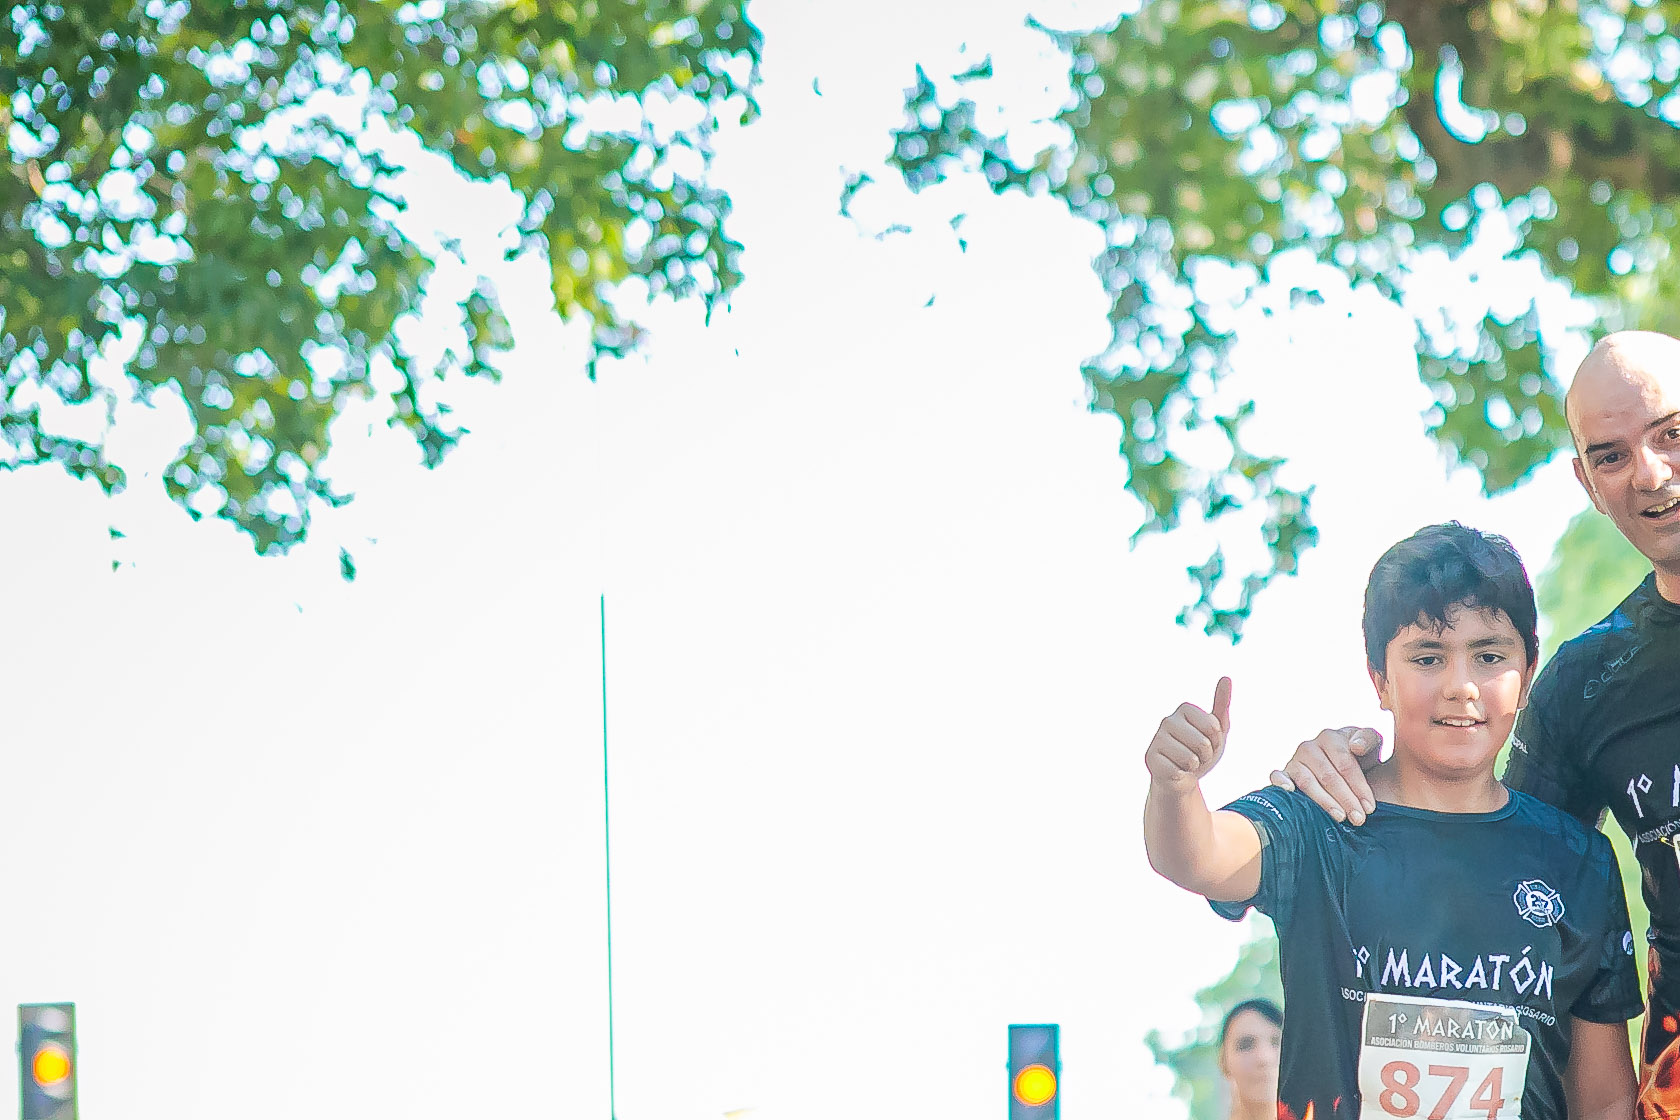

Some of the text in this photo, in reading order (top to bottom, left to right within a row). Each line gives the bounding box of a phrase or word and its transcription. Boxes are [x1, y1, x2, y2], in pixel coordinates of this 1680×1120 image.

[1381, 945, 1554, 1001] MARATÓN
[1388, 1012, 1515, 1041] 1º MARATÓN
[1413, 1041, 1454, 1052] BOMBEROS
